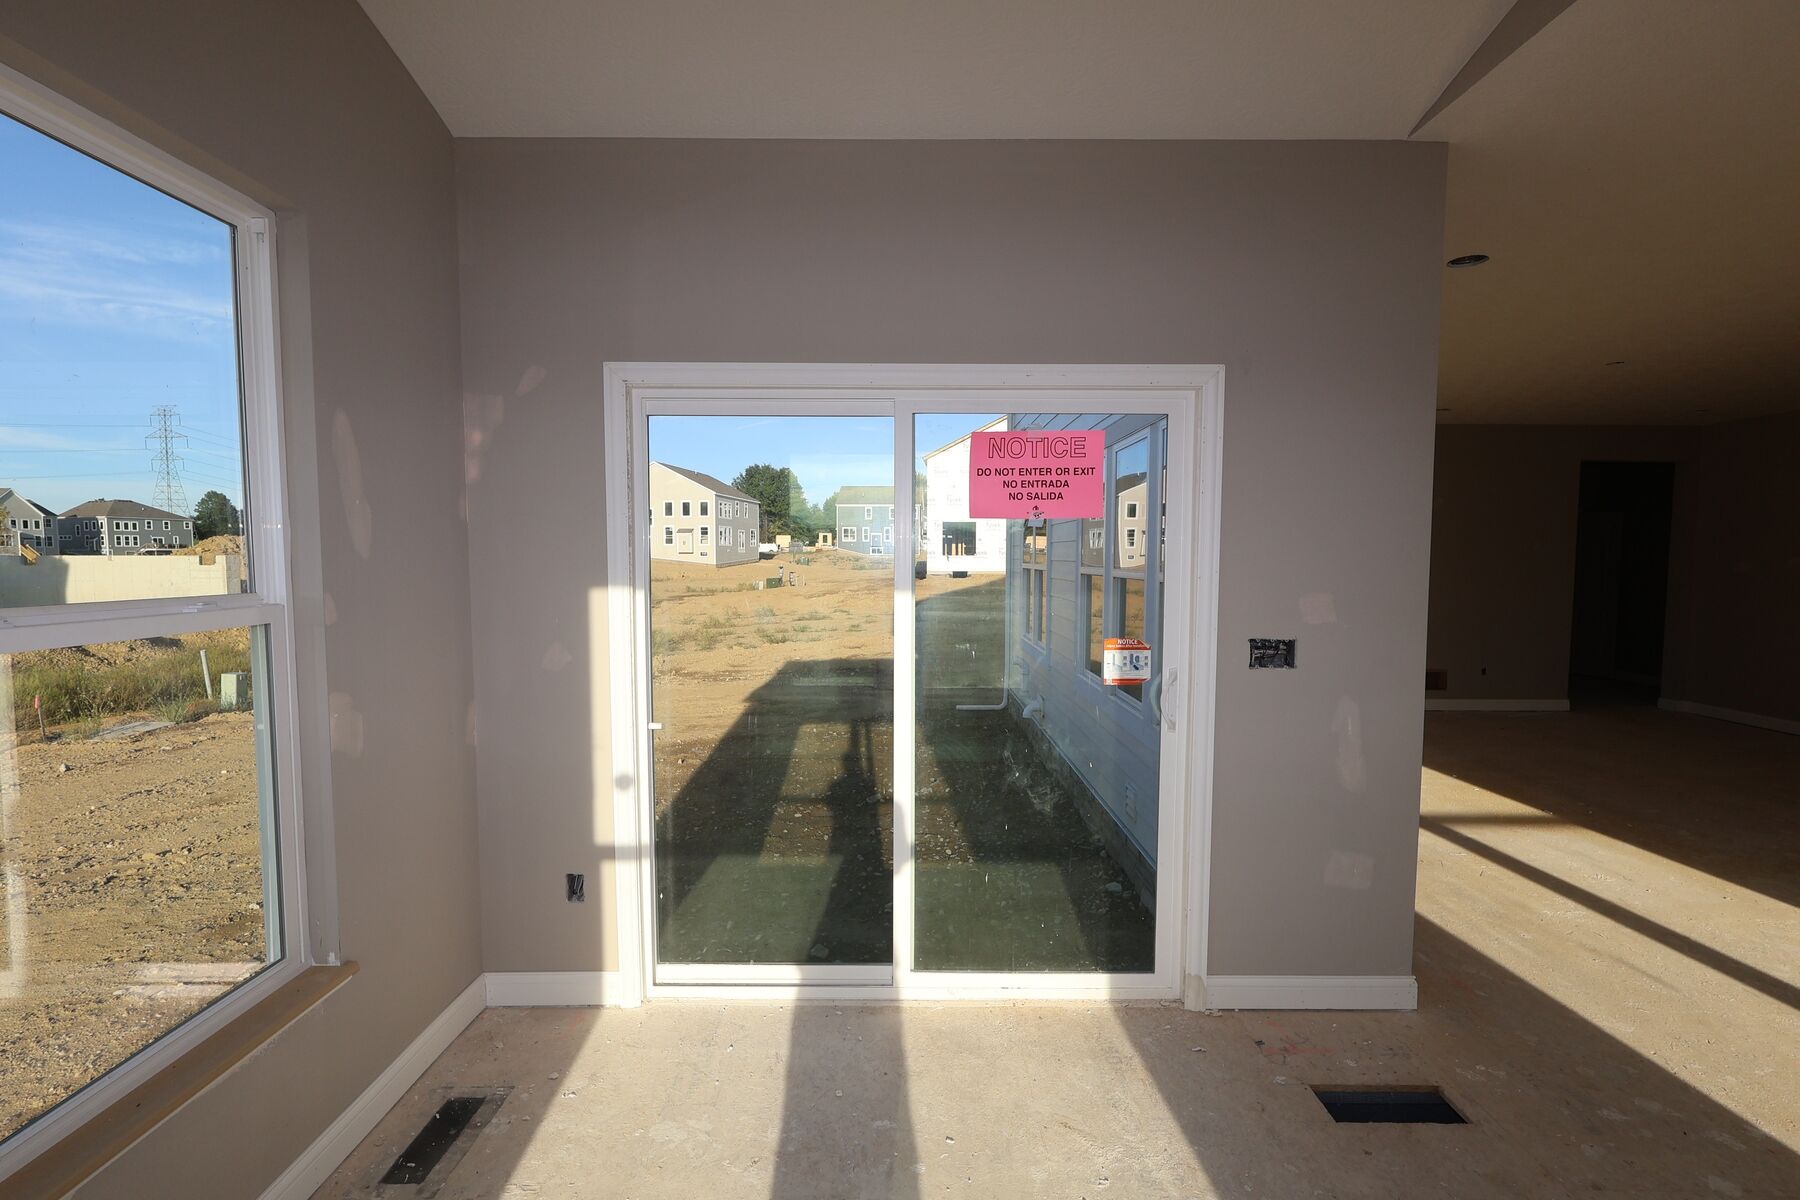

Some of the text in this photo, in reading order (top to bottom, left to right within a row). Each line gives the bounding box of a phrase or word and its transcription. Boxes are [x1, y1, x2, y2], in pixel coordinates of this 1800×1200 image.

[988, 437, 1086, 458] NOTICE
[976, 467, 1096, 476] DO NOT ENTER OR EXIT
[1002, 480, 1070, 488] NO ENTRADA
[1008, 492, 1064, 500] NO SALIDA
